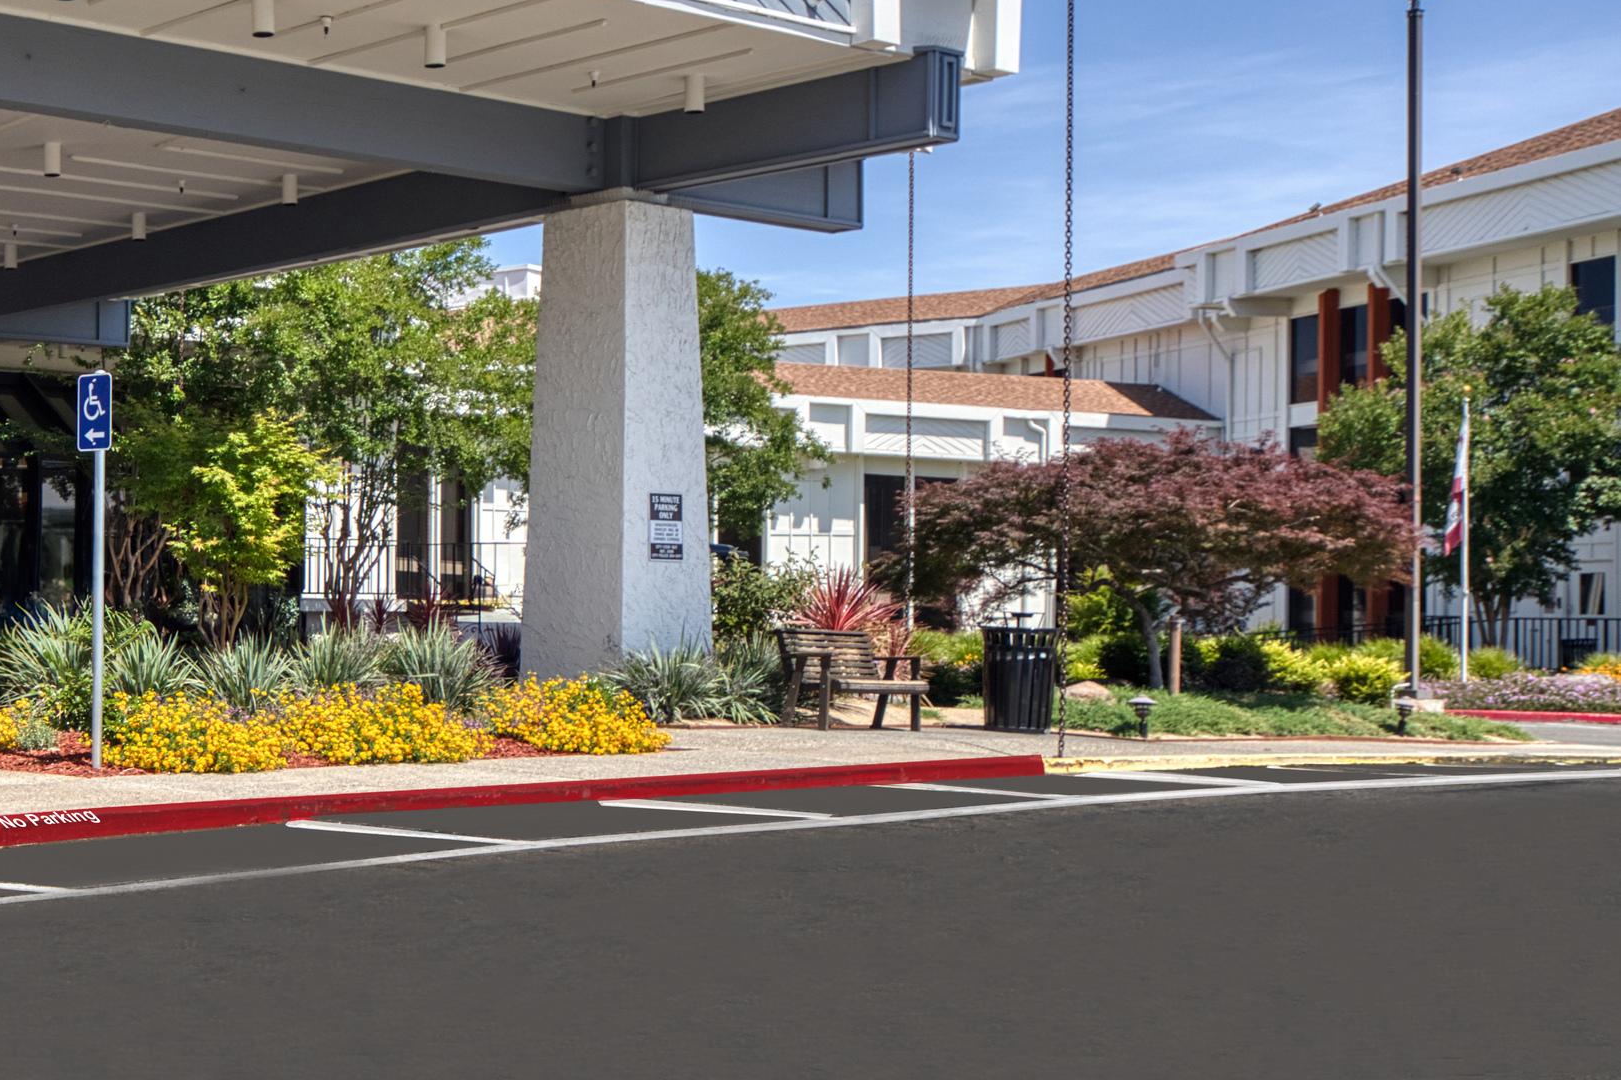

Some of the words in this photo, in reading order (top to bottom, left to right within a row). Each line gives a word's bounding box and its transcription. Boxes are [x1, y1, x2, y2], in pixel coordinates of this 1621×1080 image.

[651, 495, 659, 503] 15
[659, 495, 681, 504] MINUTE
[654, 503, 678, 512] PARKING
[659, 511, 674, 520] ONLY
[24, 810, 101, 826] Parking
